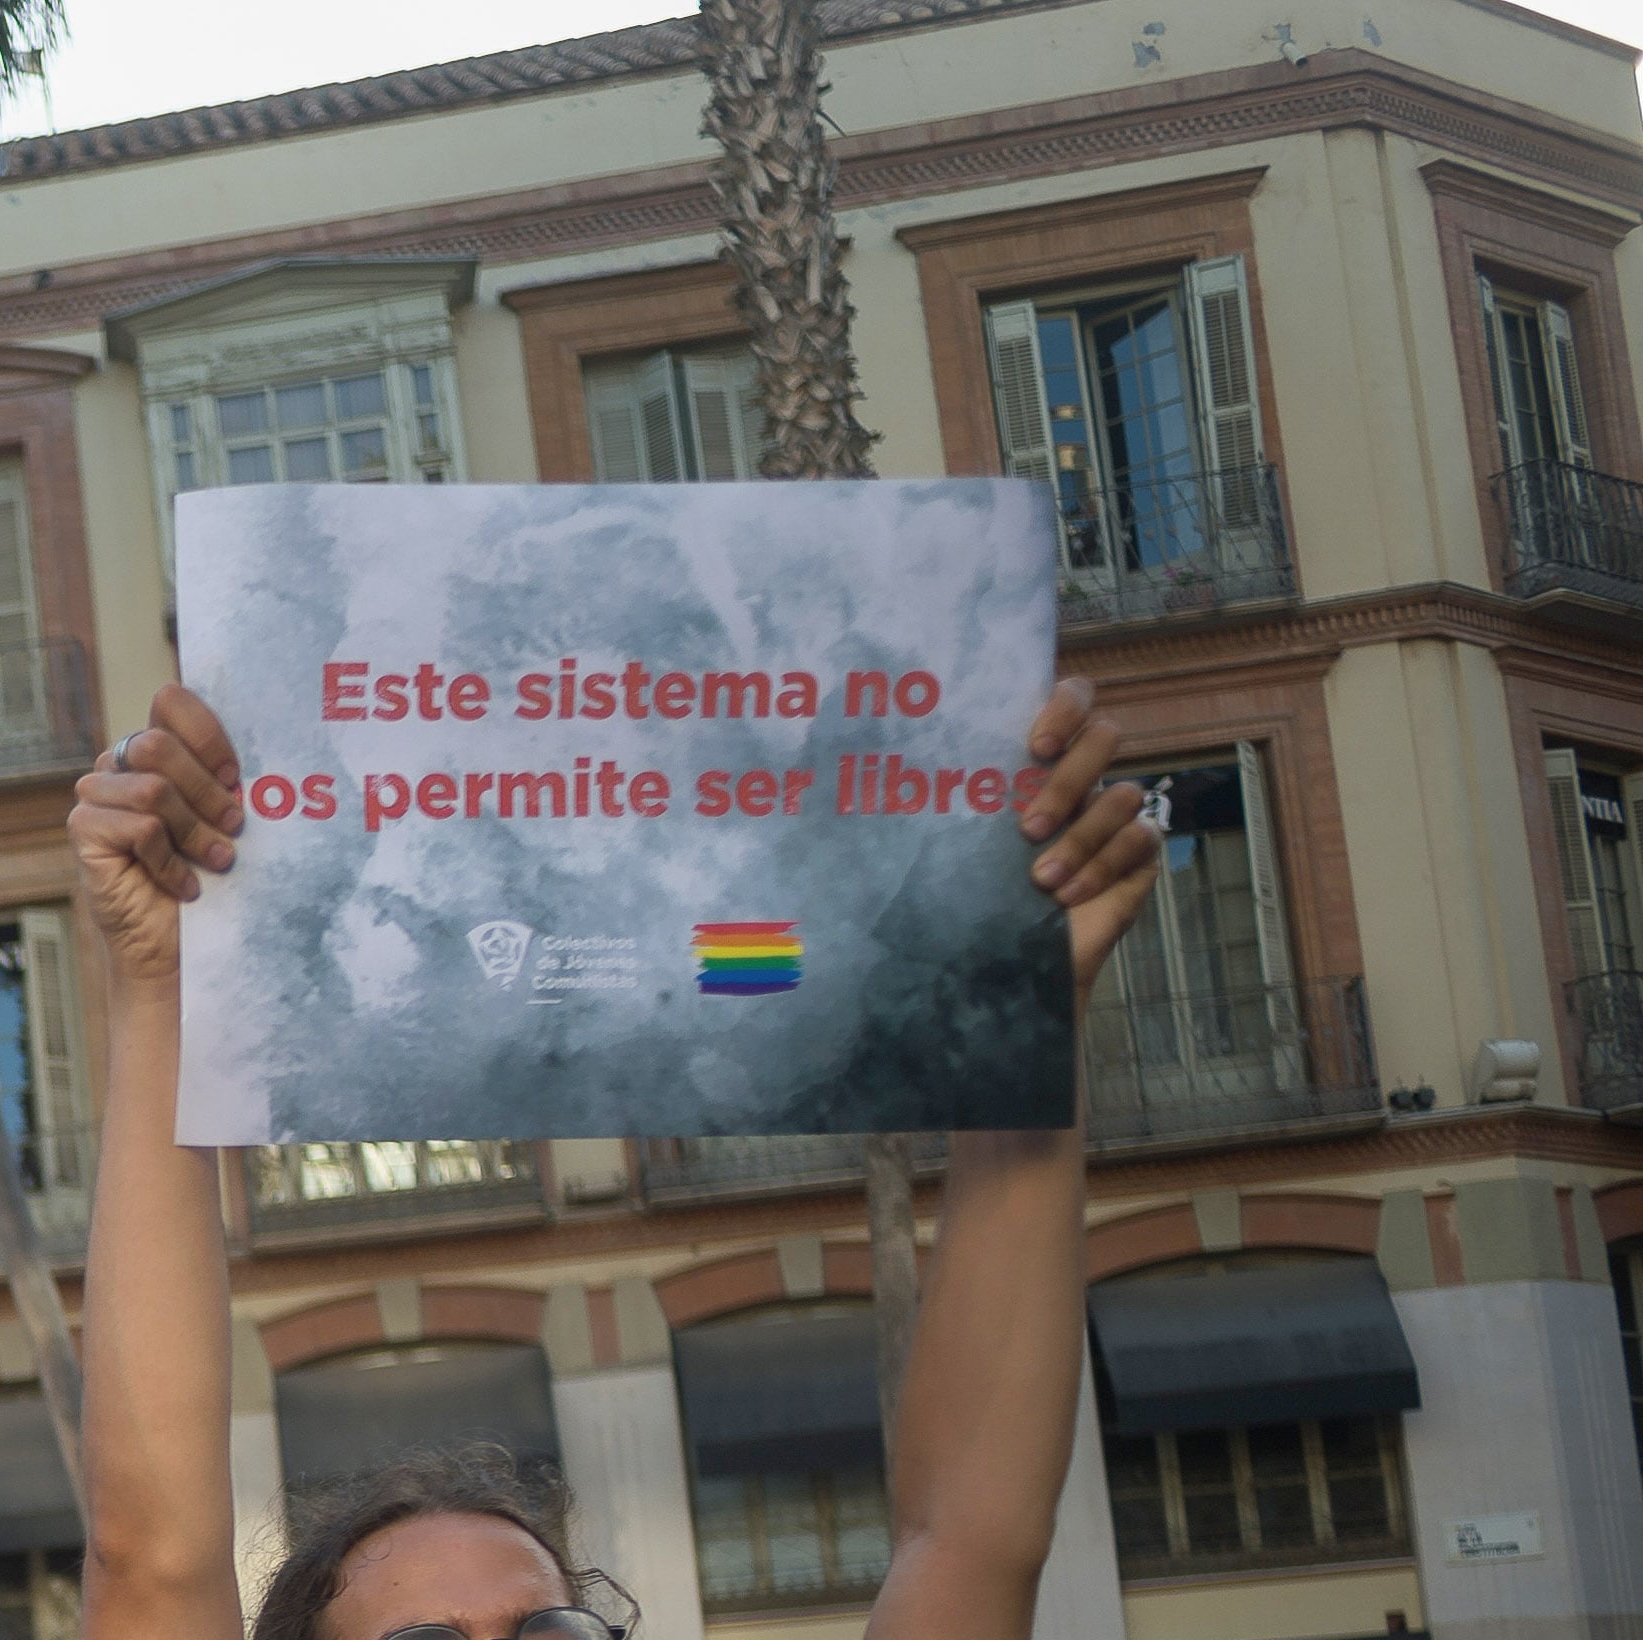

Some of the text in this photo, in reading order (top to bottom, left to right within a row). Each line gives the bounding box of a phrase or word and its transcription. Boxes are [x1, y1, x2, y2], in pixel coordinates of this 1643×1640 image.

[322, 656, 940, 721] Este sistema no
[235, 772, 337, 820] os
[364, 757, 670, 832] permite
[696, 770, 813, 816] ser
